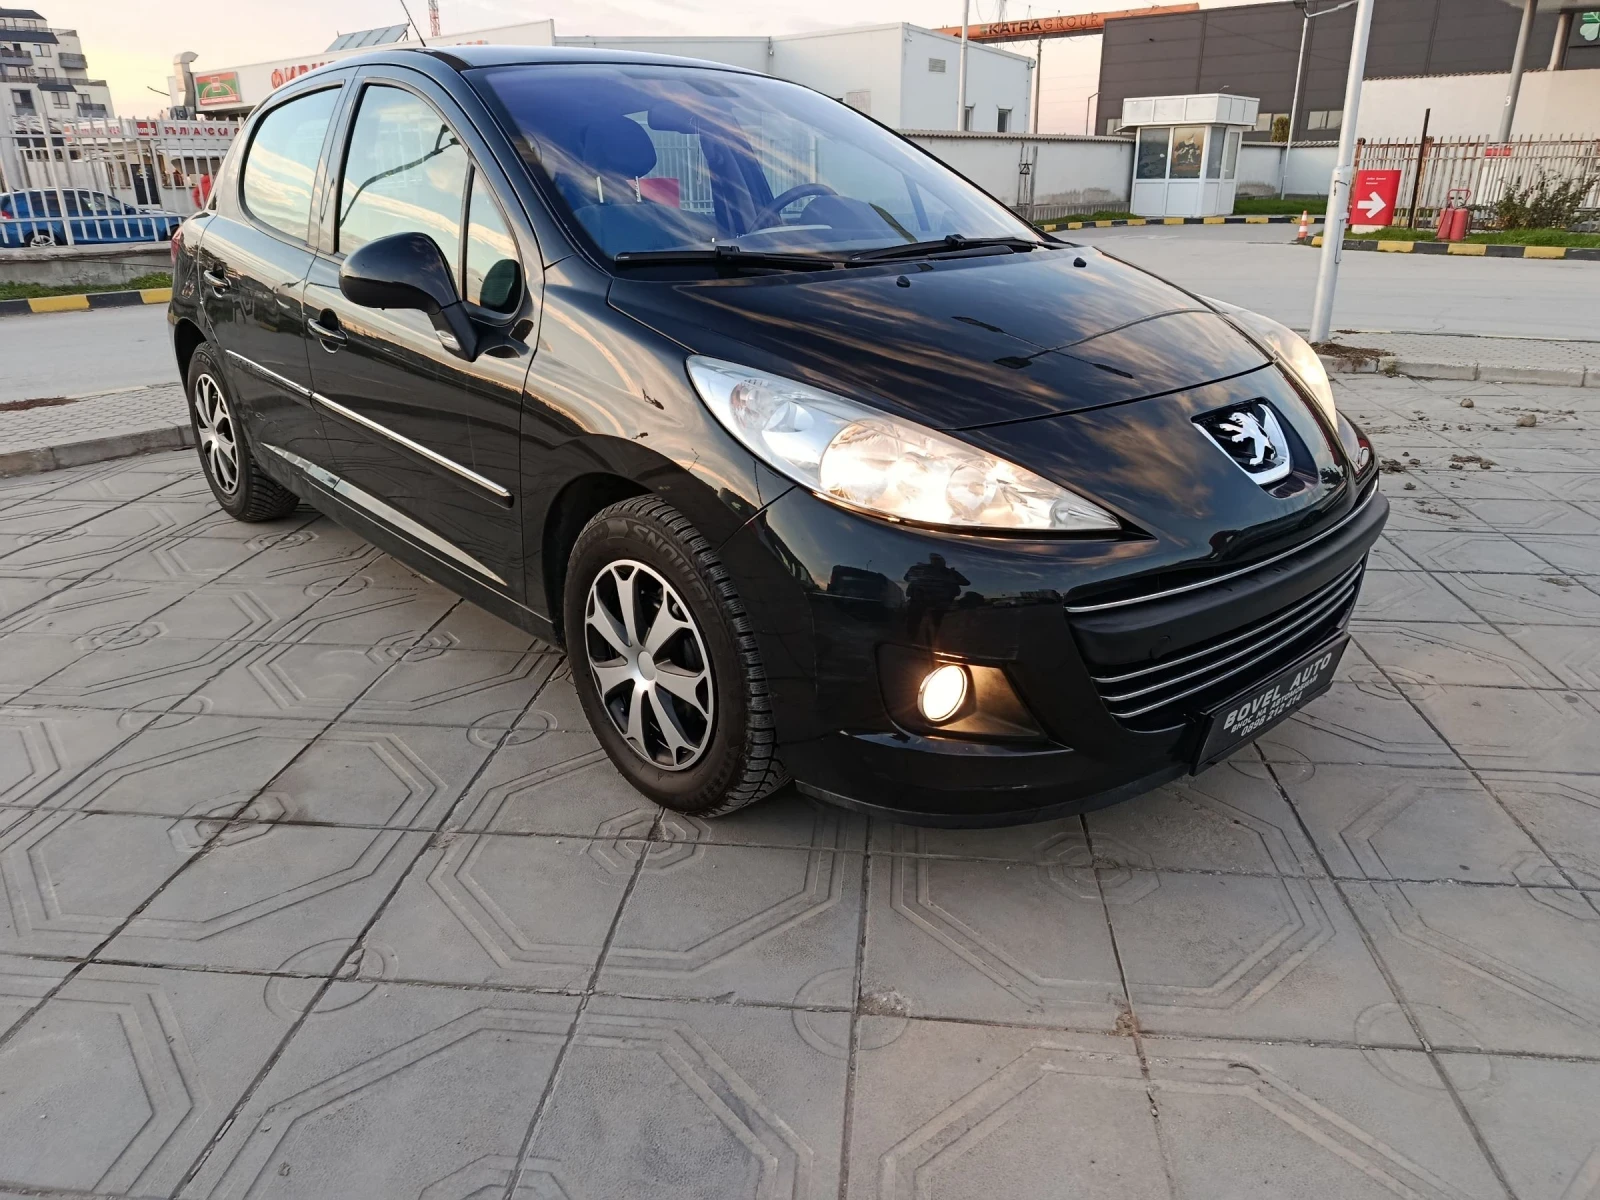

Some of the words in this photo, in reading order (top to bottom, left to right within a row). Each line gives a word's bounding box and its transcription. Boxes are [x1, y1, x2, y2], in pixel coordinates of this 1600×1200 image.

[989, 20, 1042, 35] KATRA
[1043, 14, 1099, 30] GROUP
[1223, 685, 1281, 730] BOVEL
[1289, 652, 1332, 691] AUTO
[1266, 703, 1286, 722] 212
[1285, 691, 1303, 708] 414
